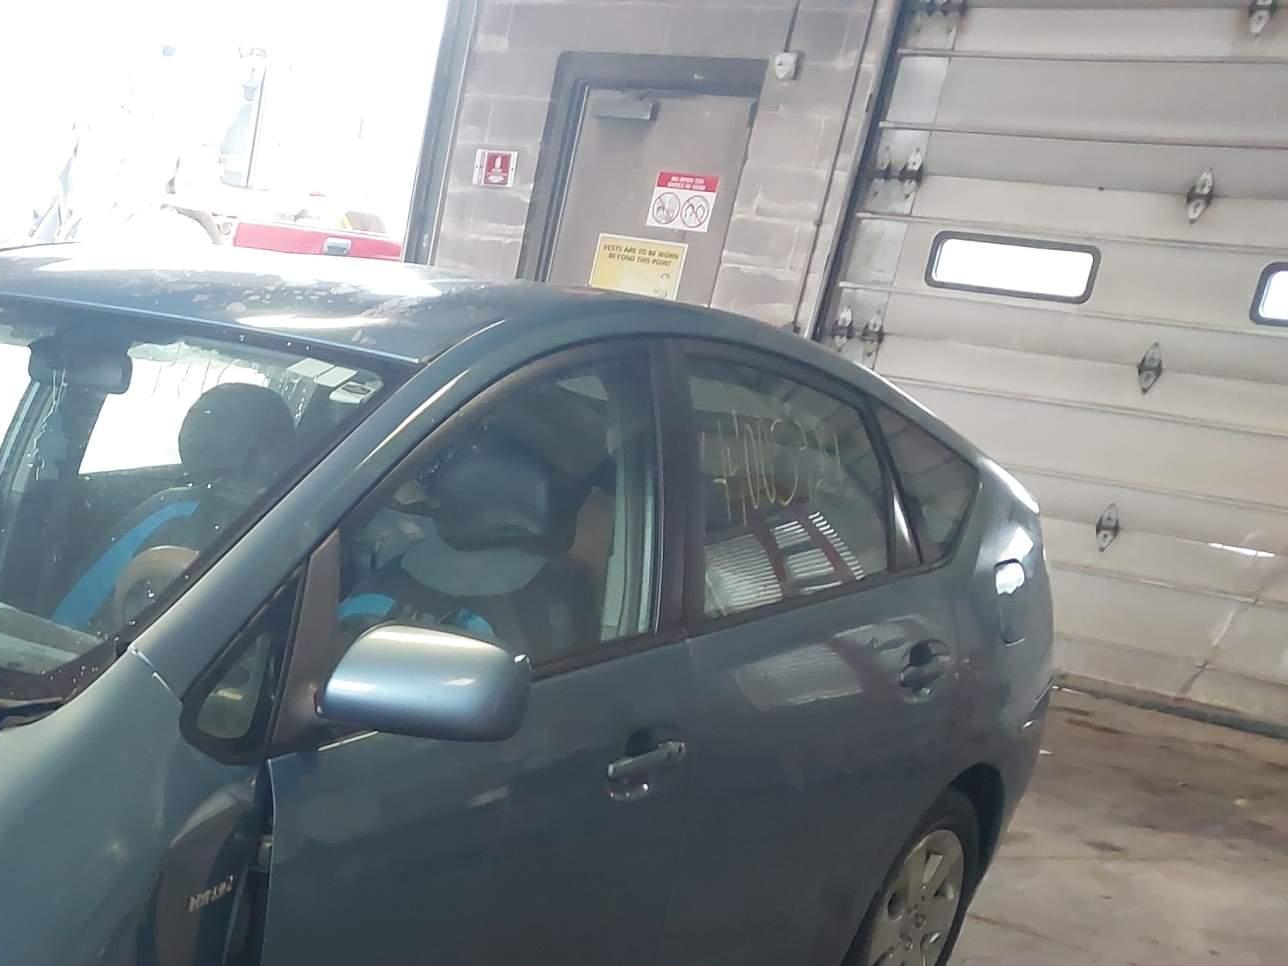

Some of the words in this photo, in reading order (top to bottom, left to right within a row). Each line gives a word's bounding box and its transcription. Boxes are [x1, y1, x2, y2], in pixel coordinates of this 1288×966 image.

[603, 244, 623, 252] VESTS
[624, 246, 637, 254] ARE
[638, 247, 647, 256] TO
[648, 249, 657, 257] BE
[608, 252, 635, 262] BEYOND
[637, 255, 651, 264] THIS
[651, 257, 672, 267] POINT
